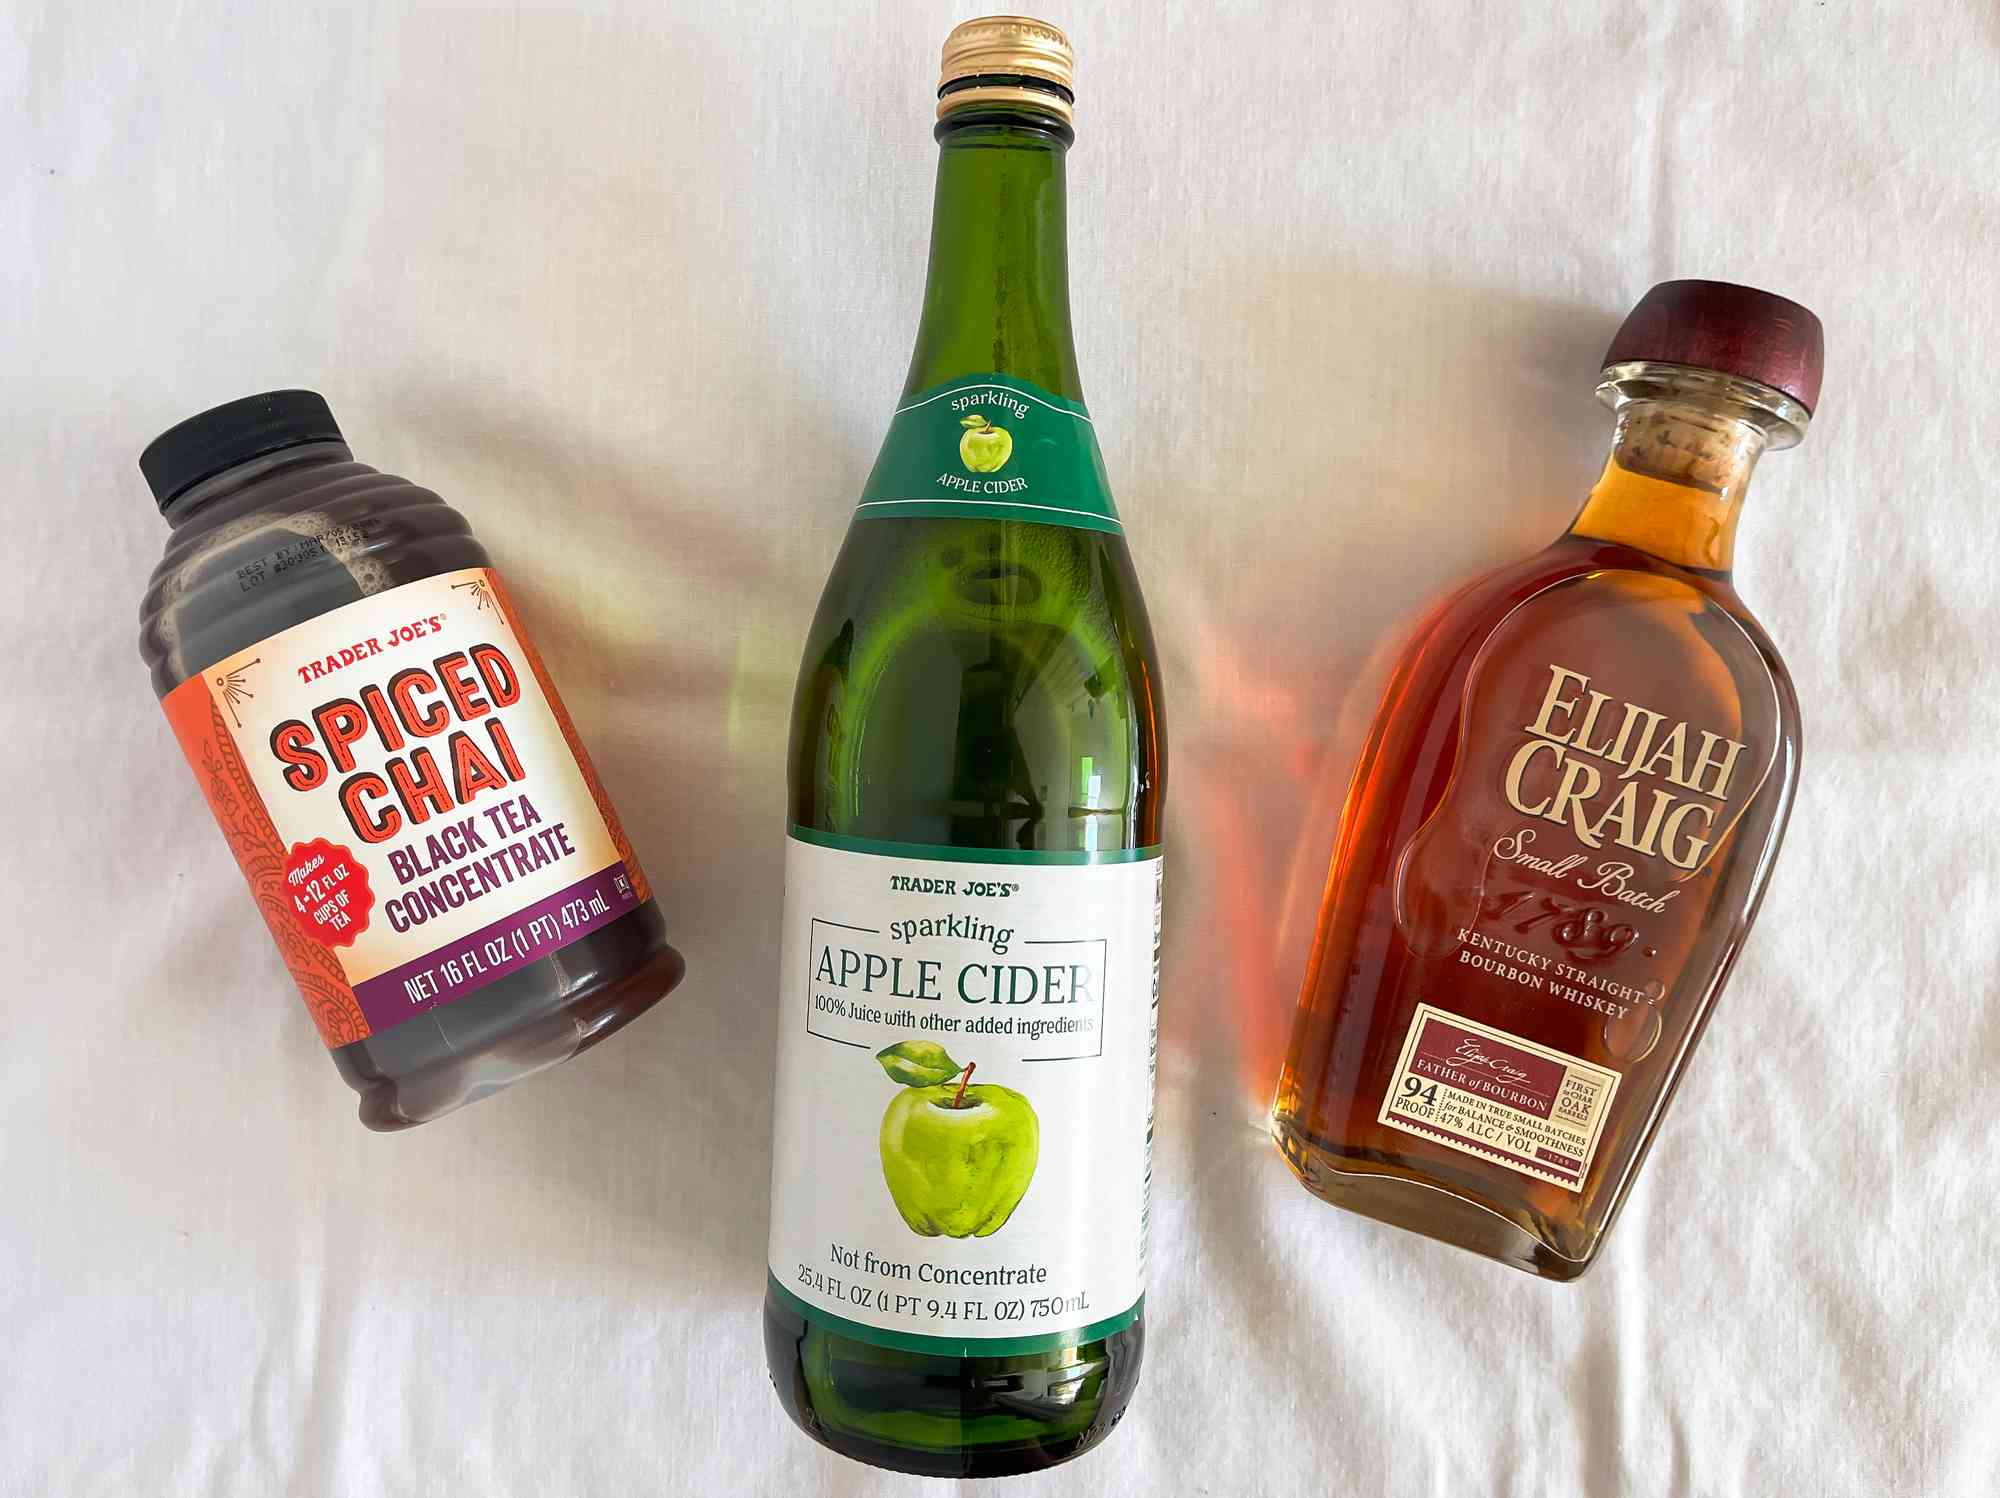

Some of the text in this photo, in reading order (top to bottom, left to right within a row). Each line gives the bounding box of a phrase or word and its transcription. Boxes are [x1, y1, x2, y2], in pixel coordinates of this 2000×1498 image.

[951, 391, 1029, 419] sparkling
[937, 473, 1029, 495] APPLE CIDER
[297, 637, 383, 684] TRADER
[269, 642, 521, 792] SPICED
[1525, 664, 1747, 801] ELIJAH
[338, 716, 526, 844] CHAI
[1505, 738, 1717, 872] CRAIG
[387, 794, 542, 885] BLACK TEA
[288, 854, 325, 886] Makes
[294, 863, 350, 912] 4-12 FL OZ
[384, 822, 576, 934] CONCENTRATE
[890, 875, 956, 895] TRADER
[1493, 828, 1681, 914] Small Batch
[313, 889, 350, 925] CUPS OF
[329, 911, 352, 931] TEA
[403, 890, 610, 1004] NET 16 FL OZ (1 PT) 473 mL
[890, 914, 1015, 955] sparkling
[815, 945, 1096, 1005] APPLE CIDER
[1457, 928, 1645, 1004] KENTUCKY STRAIGHT
[1459, 951, 1629, 1019] BOURBON WHISKEY
[815, 994, 1095, 1041] 100% Juice with other added ingredients
[1395, 1096, 1436, 1119] PROOF
[1401, 1077, 1438, 1107] 94
[1417, 1059, 1549, 1112] FATHER of BOURBON
[1562, 1097, 1592, 1114] OAK
[1566, 1080, 1597, 1096] FIRST
[1439, 1113, 1463, 1129] 47%
[1466, 1121, 1495, 1140] ALC
[1506, 1133, 1532, 1153] VOL
[1444, 1101, 1457, 1114] for
[1457, 1106, 1506, 1129] BALANCE
[1514, 1125, 1585, 1157] SMOOTHNESS
[1447, 1090, 1587, 1146] MADE IN TRUE SMALL BATCHES
[830, 1243, 1048, 1287] Not from Concentrate
[797, 1264, 825, 1293] 25.4
[827, 1278, 846, 1301] FL
[850, 1286, 872, 1309] OZ
[876, 1290, 890, 1314] (1
[895, 1295, 922, 1316] PT
[927, 1299, 958, 1320] 9.4
[964, 1300, 988, 1321] FL
[993, 1299, 1025, 1322] OZ)
